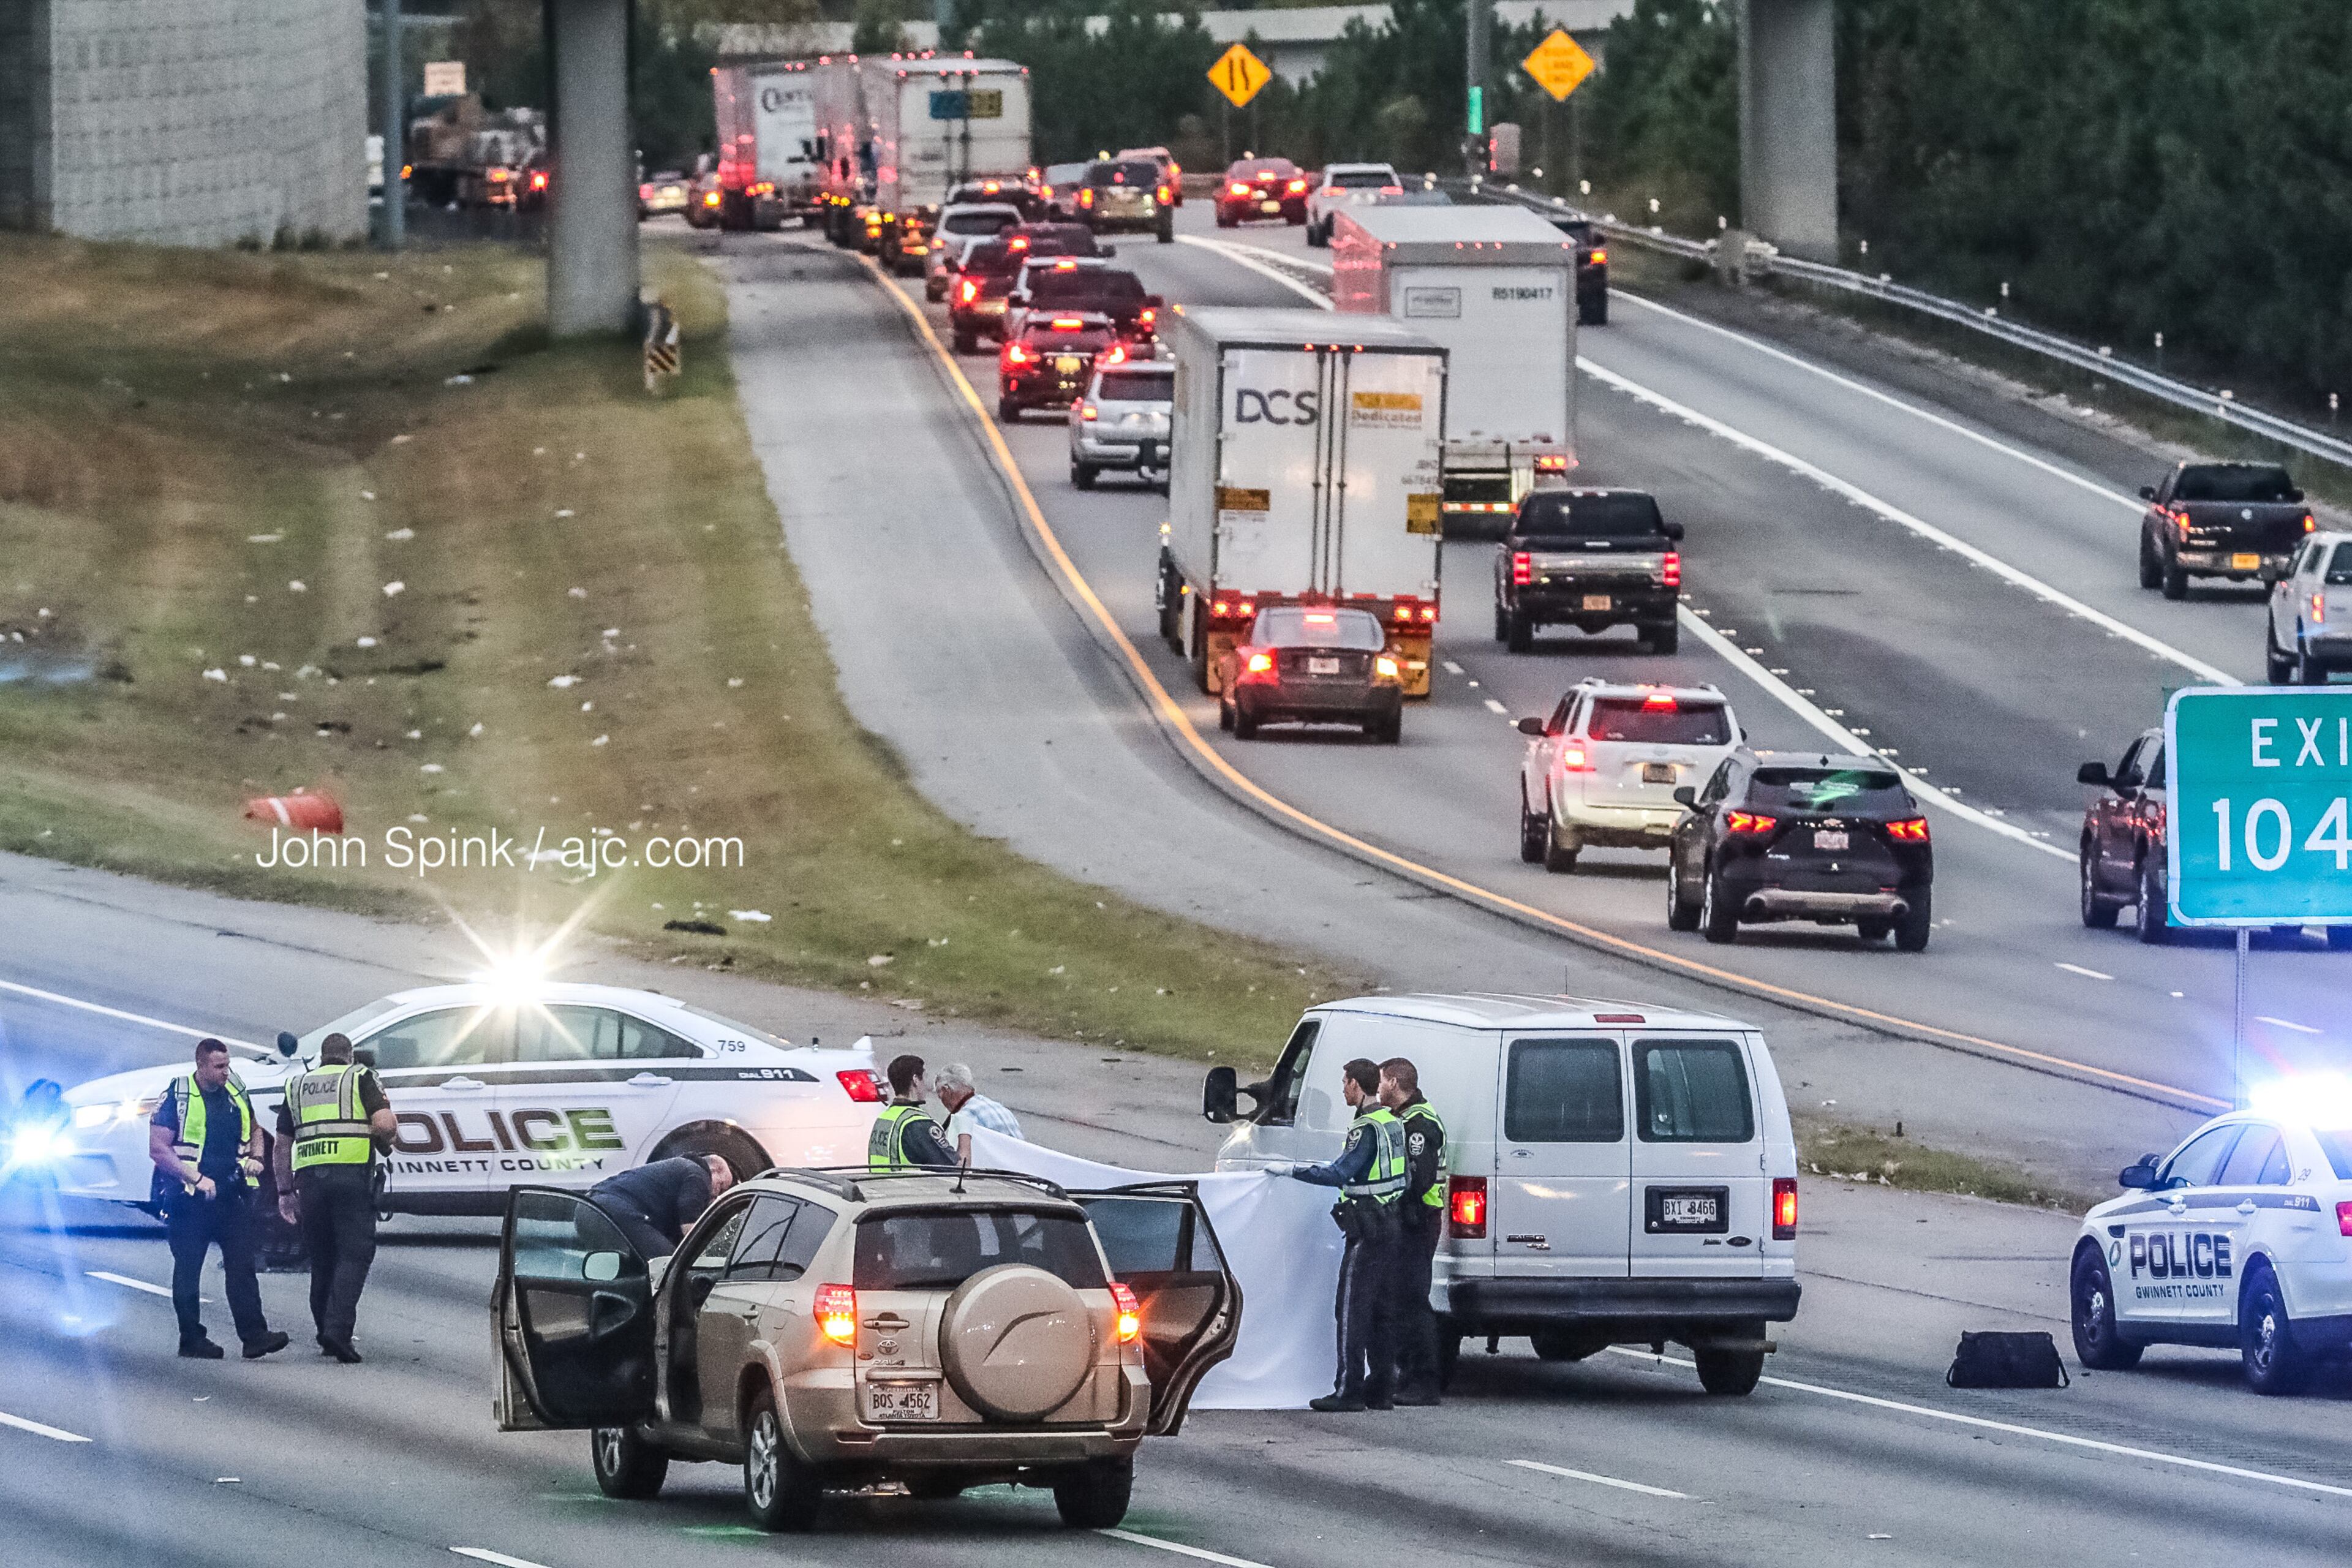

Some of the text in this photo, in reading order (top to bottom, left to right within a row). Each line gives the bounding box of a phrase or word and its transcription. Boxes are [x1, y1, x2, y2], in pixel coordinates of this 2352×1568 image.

[1236, 388, 1318, 426] DCS
[1351, 410, 1421, 422] Dedicated
[2212, 797, 2352, 871] 104
[717, 1040, 745, 1052] 759
[760, 1069, 794, 1079] 911
[302, 1081, 336, 1095] POLICE
[392, 1107, 626, 1155] OLICE
[500, 1158, 604, 1172] COUNTY
[1665, 1200, 1715, 1215] BXI 8466
[2294, 1196, 2310, 1207] 911
[2129, 1232, 2233, 1280] POLICE
[2136, 1284, 2224, 1298] GWINNETT COUNTY
[902, 1393, 930, 1409] 4562
